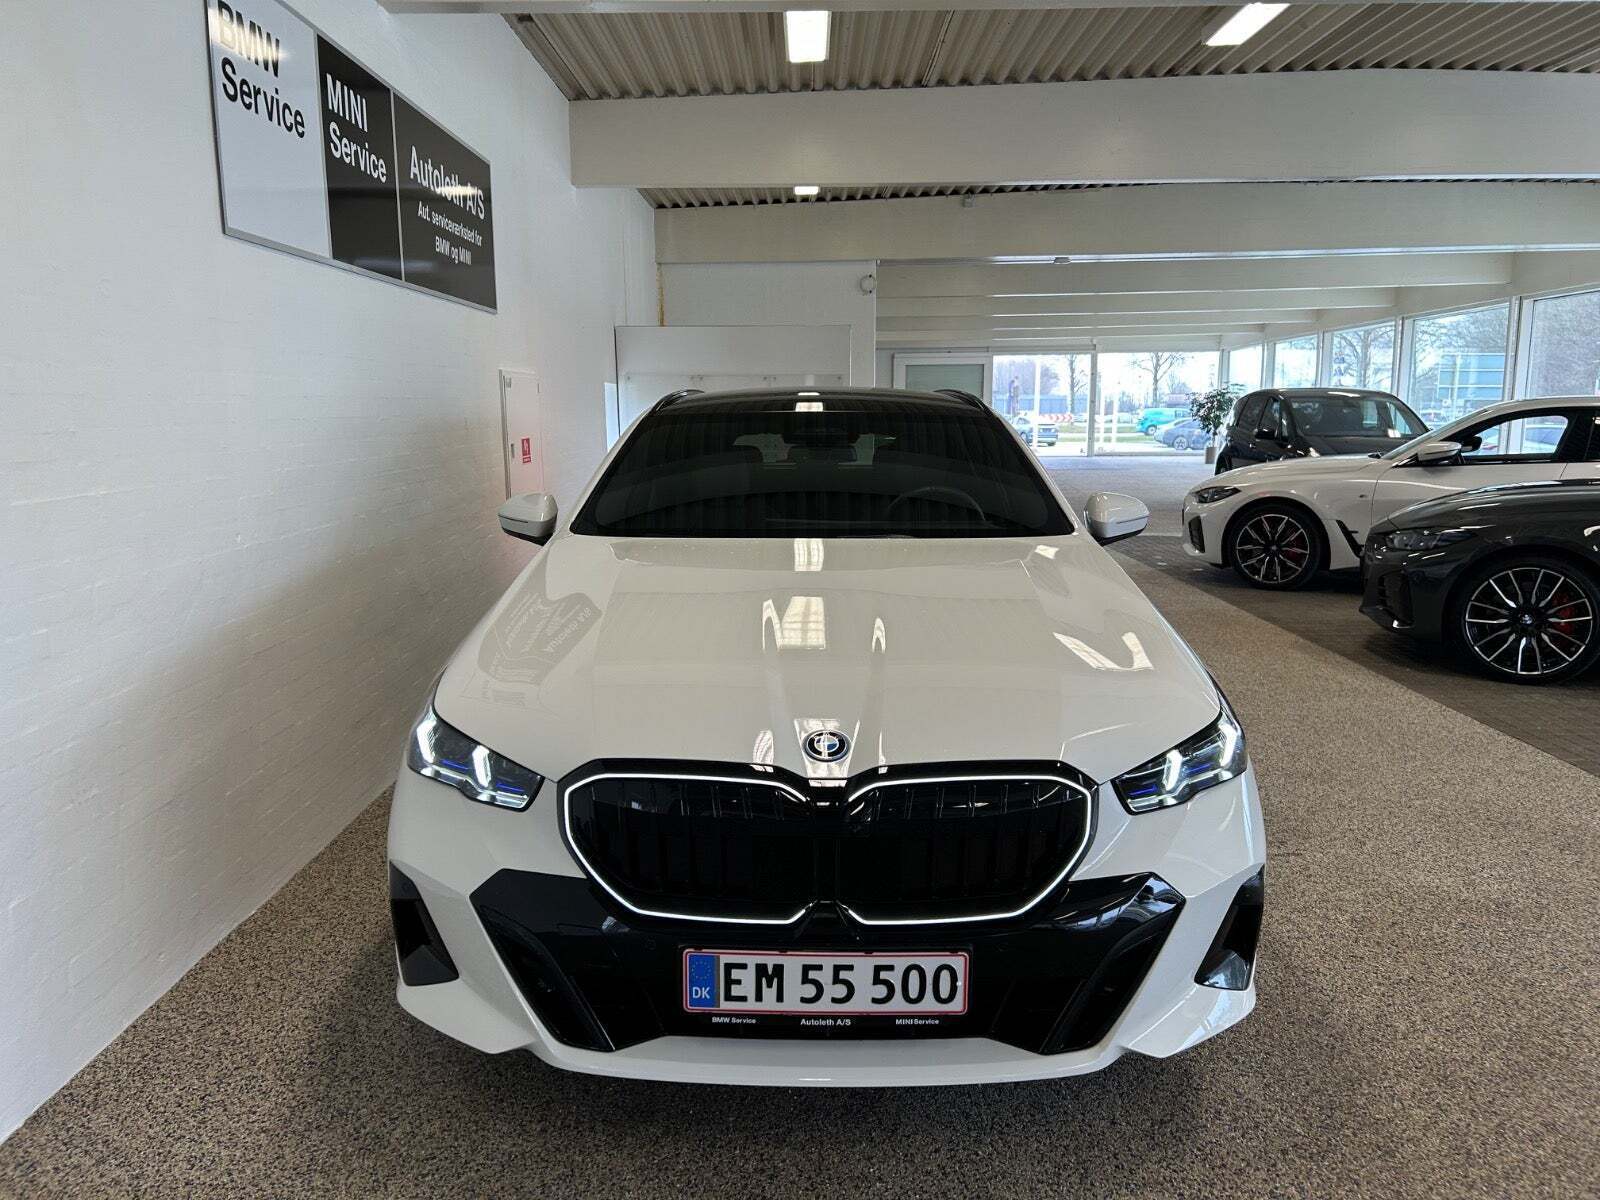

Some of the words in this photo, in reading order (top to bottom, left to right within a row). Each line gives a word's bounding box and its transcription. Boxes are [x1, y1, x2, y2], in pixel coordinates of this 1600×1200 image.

[217, 0, 280, 78] BMW
[221, 56, 305, 139] Service
[326, 73, 369, 132] MINI
[329, 121, 387, 184] Service
[410, 145, 464, 208] Autoleth
[466, 182, 485, 220] A/S
[418, 200, 431, 222] Aut.
[435, 236, 450, 257] BMW
[450, 246, 459, 264] og
[459, 246, 472, 266] MINI
[692, 986, 710, 999] DK
[723, 962, 785, 1003] EM
[799, 964, 855, 1004] 55
[871, 963, 959, 1004] 500
[712, 1016, 730, 1024] BMW
[731, 1016, 757, 1024] Service
[800, 1018, 835, 1026] Autoleth
[836, 1018, 852, 1026] A/S
